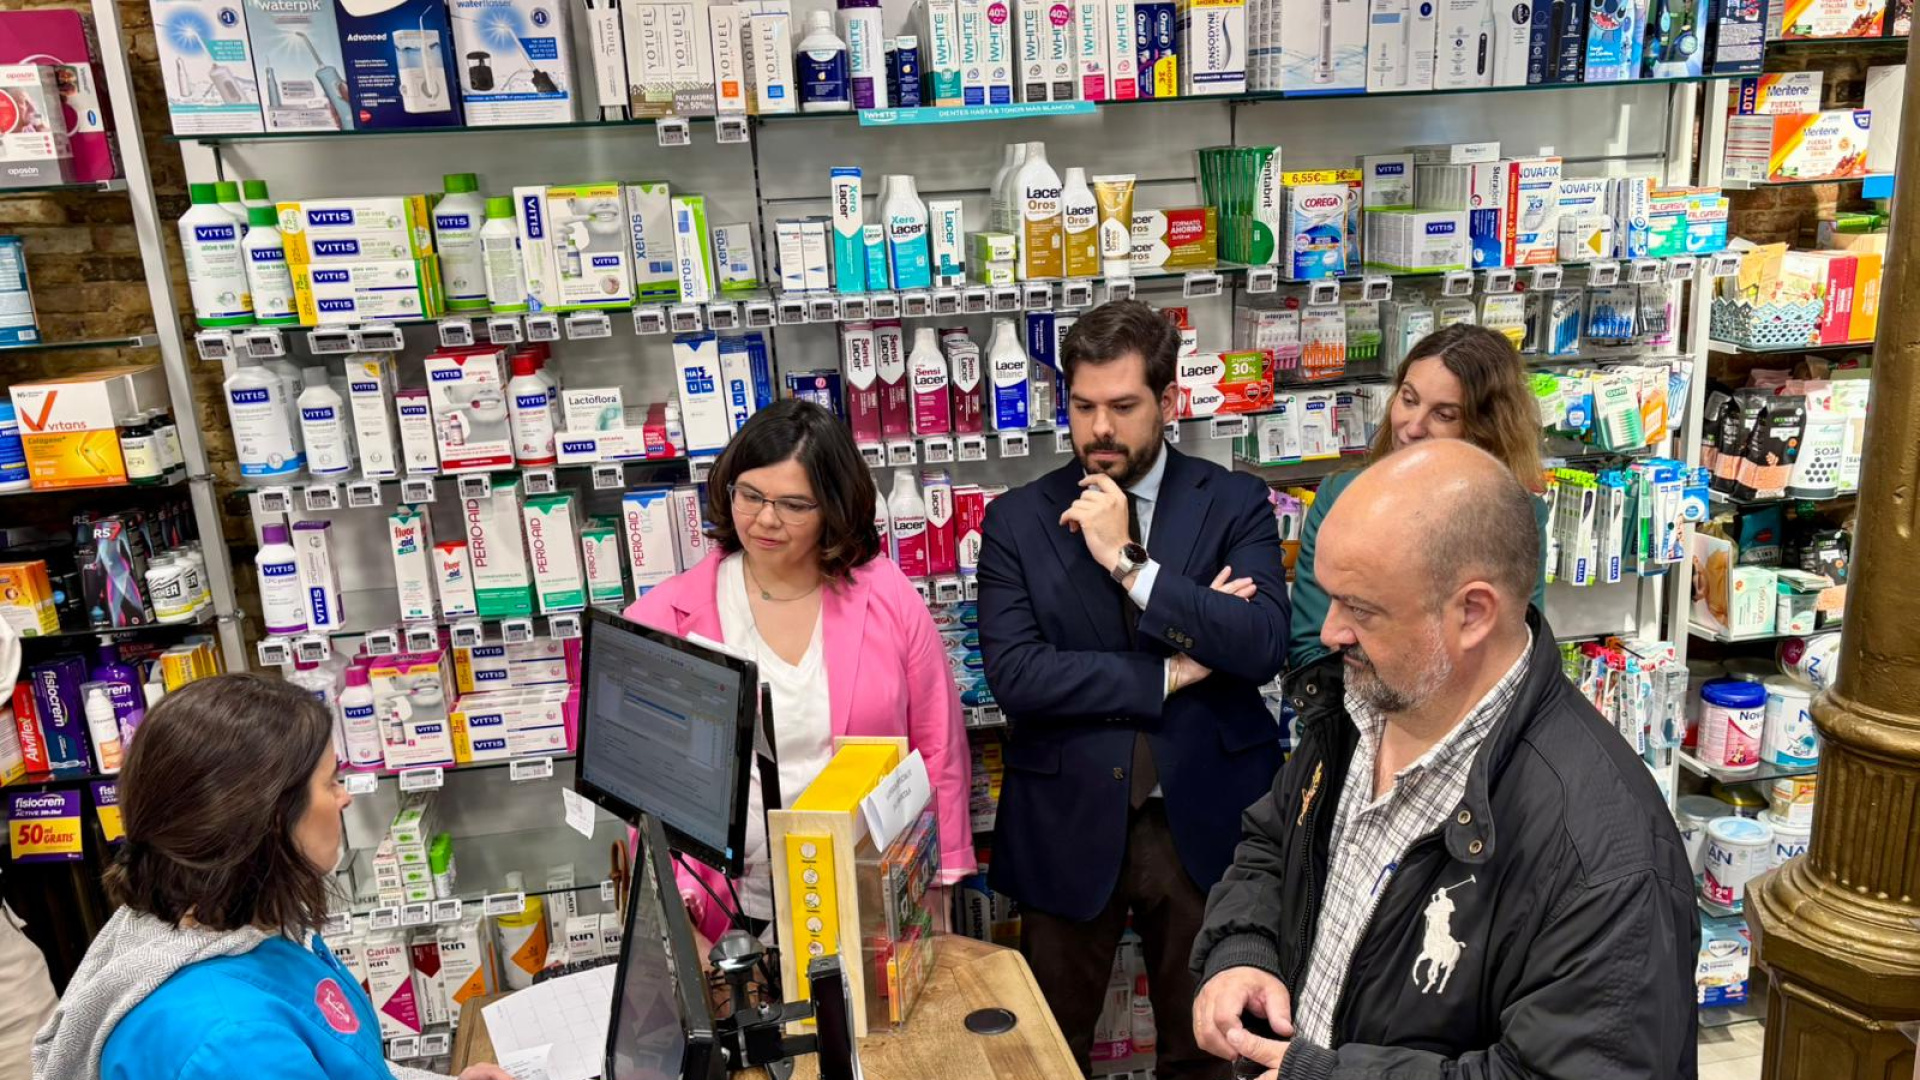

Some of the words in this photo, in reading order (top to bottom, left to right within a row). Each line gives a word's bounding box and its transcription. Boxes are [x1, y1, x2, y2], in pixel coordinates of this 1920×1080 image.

[347, 34, 387, 42] Advanced
[643, 9, 656, 69] YOTUEL
[672, 9, 684, 68] YOTUEL
[1207, 11, 1216, 70] SENSODYNE
[762, 24, 775, 83] YOTUEL
[1767, 85, 1810, 97] Meritene
[1803, 127, 1839, 137] Meritene
[1377, 165, 1403, 174] VITIS
[1262, 152, 1274, 208] Dentabrit
[1027, 187, 1062, 199] Lacer
[1560, 182, 1602, 194] NOVAFIX
[838, 183, 848, 219] Lacer
[849, 185, 857, 213] Xero
[1028, 199, 1056, 210] Oros
[1305, 197, 1339, 208] COREGA
[310, 212, 350, 220] VITIS
[1066, 204, 1096, 216] Lacer
[436, 216, 469, 227] VITIS
[528, 198, 541, 237] VITIS
[891, 215, 915, 225] Xero
[1067, 215, 1090, 225] Oros
[197, 227, 234, 238] VITIS
[890, 223, 923, 235] Lacer
[944, 210, 955, 247] Lacer
[1428, 223, 1455, 233] VITIS
[633, 214, 647, 260] xeros
[317, 243, 356, 252] VITIS
[714, 229, 729, 267] xeros
[252, 250, 283, 261] VITIS
[593, 258, 618, 266] VITIS
[314, 271, 347, 281] VITIS
[681, 257, 694, 298] xeros
[320, 300, 352, 310] VITIS
[852, 337, 862, 372] Lacer
[861, 337, 871, 368] Sensi
[880, 333, 889, 367] Lacer
[889, 333, 900, 364] Sensi
[959, 355, 968, 385] Lacer
[968, 356, 976, 381] Sensi
[995, 359, 1026, 371] Lacer
[1232, 361, 1256, 376] 30%
[433, 371, 461, 380] VITIS
[685, 370, 697, 378] HA
[915, 367, 941, 377] Sensi
[1181, 365, 1218, 378] Lacer
[914, 374, 948, 387] Lacer
[353, 383, 378, 391] VITIS
[232, 391, 267, 402] VITIS
[518, 395, 546, 406] VITIS
[569, 394, 617, 406] Lactoflora
[1192, 393, 1220, 405] Lacer
[303, 409, 332, 419] VITIS
[402, 406, 427, 415] VITIS
[48, 419, 87, 432] vitans
[564, 441, 595, 452] VITIS
[1814, 447, 1841, 457] SOJA
[931, 489, 940, 518] Lacer
[686, 496, 700, 548] PERIO-AID
[894, 520, 925, 531] Lacer
[466, 498, 487, 568] PERIO-AID
[628, 510, 645, 567] PERIO-AID
[531, 517, 548, 574] PERIO-AID
[583, 540, 598, 580] PERIO-AID
[265, 563, 295, 575] VITIS
[312, 589, 326, 623] VITIS
[473, 647, 503, 657] VITIS
[477, 670, 505, 680] VITIS
[42, 669, 65, 727] fisiocrem
[346, 706, 374, 717] VITIS
[471, 715, 501, 726] VITIS
[416, 724, 442, 734] VITIS
[474, 740, 505, 750] VITIS
[15, 797, 65, 809] fisiocrem
[17, 823, 44, 846] 50
[43, 833, 73, 844] GRATIS
[366, 944, 402, 957] Cariax
